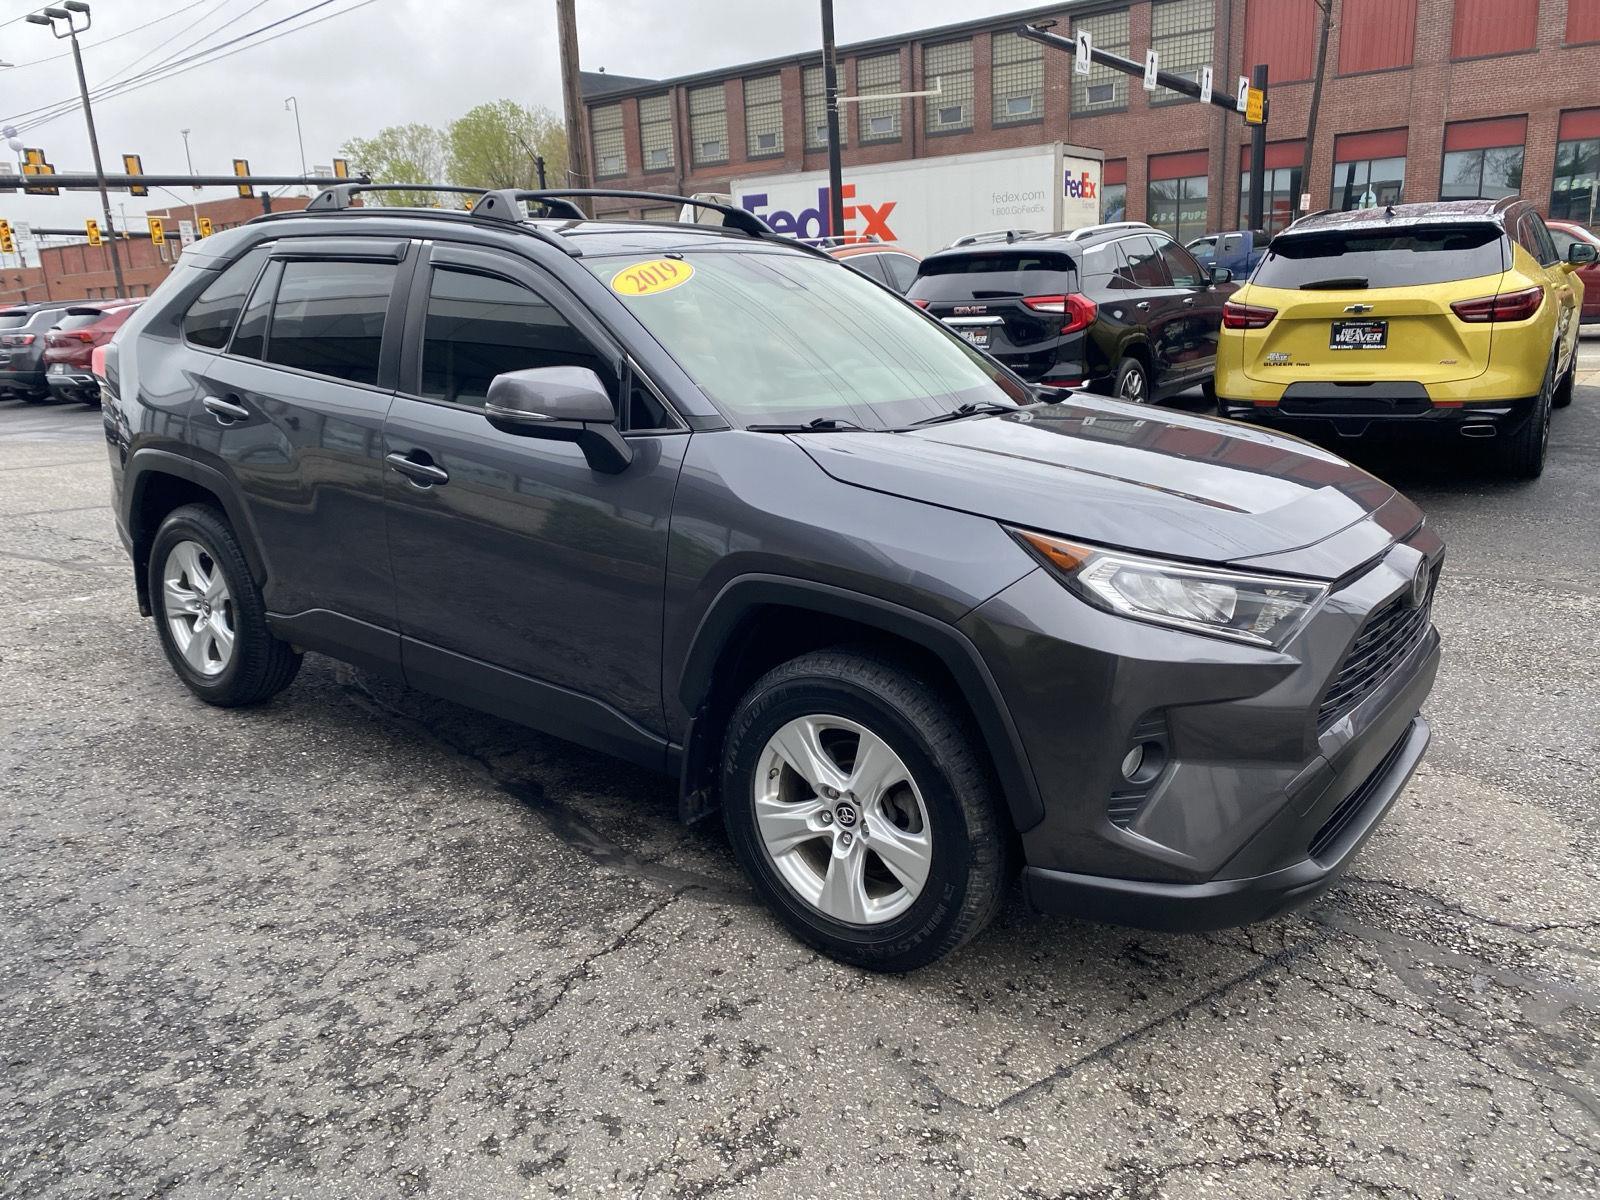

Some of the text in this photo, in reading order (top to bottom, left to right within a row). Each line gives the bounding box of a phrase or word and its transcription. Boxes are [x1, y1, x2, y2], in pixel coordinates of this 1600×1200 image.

[1064, 170, 1097, 199] FedEx
[992, 190, 1045, 204] fedex.com
[742, 184, 898, 248] FedEx
[625, 261, 678, 292] 2019
[953, 305, 987, 315] GMC
[1335, 333, 1382, 342] WEAVER
[1341, 328, 1363, 336] RICK
